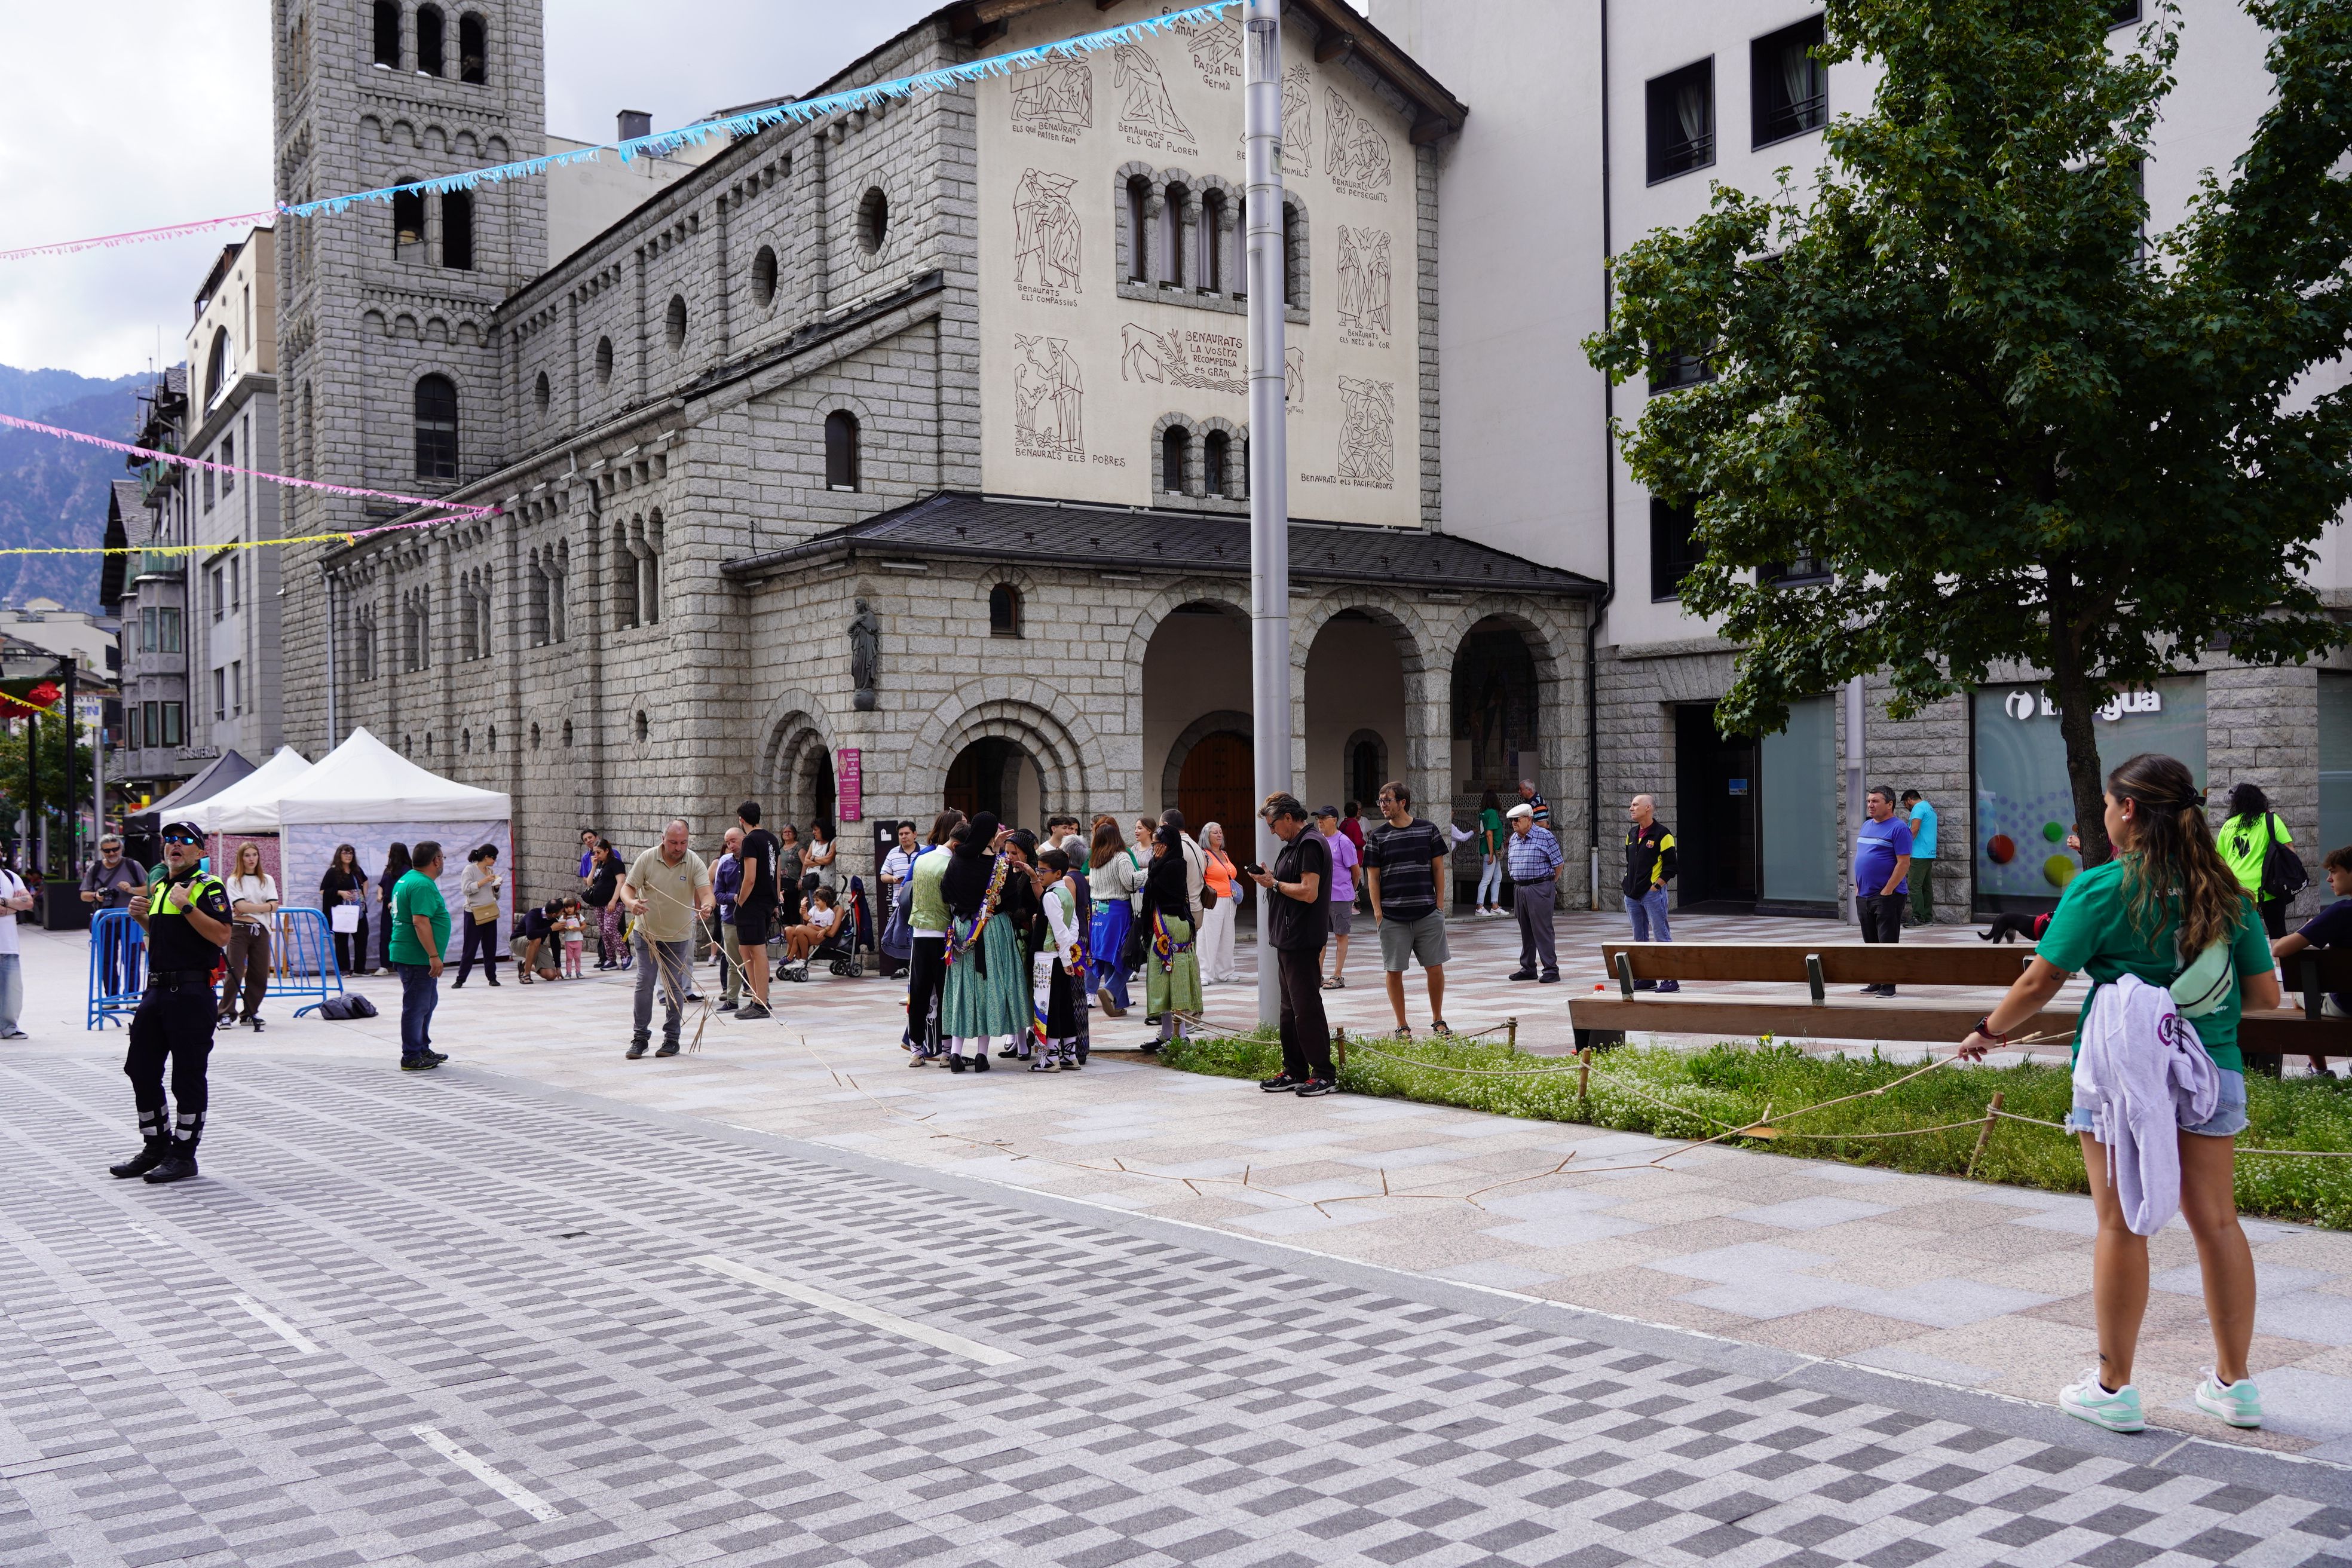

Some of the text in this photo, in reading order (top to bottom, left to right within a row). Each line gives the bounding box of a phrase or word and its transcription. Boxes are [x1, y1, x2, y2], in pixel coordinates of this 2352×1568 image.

[1194, 54, 1241, 76] PASSA PEL
[1012, 124, 1024, 133] ELS
[1061, 134, 1076, 145] FAM
[1127, 136, 1141, 145] ELS
[1190, 344, 1202, 354] LA
[1068, 454, 1086, 463] ELS
[1092, 455, 1126, 467] POBRES
